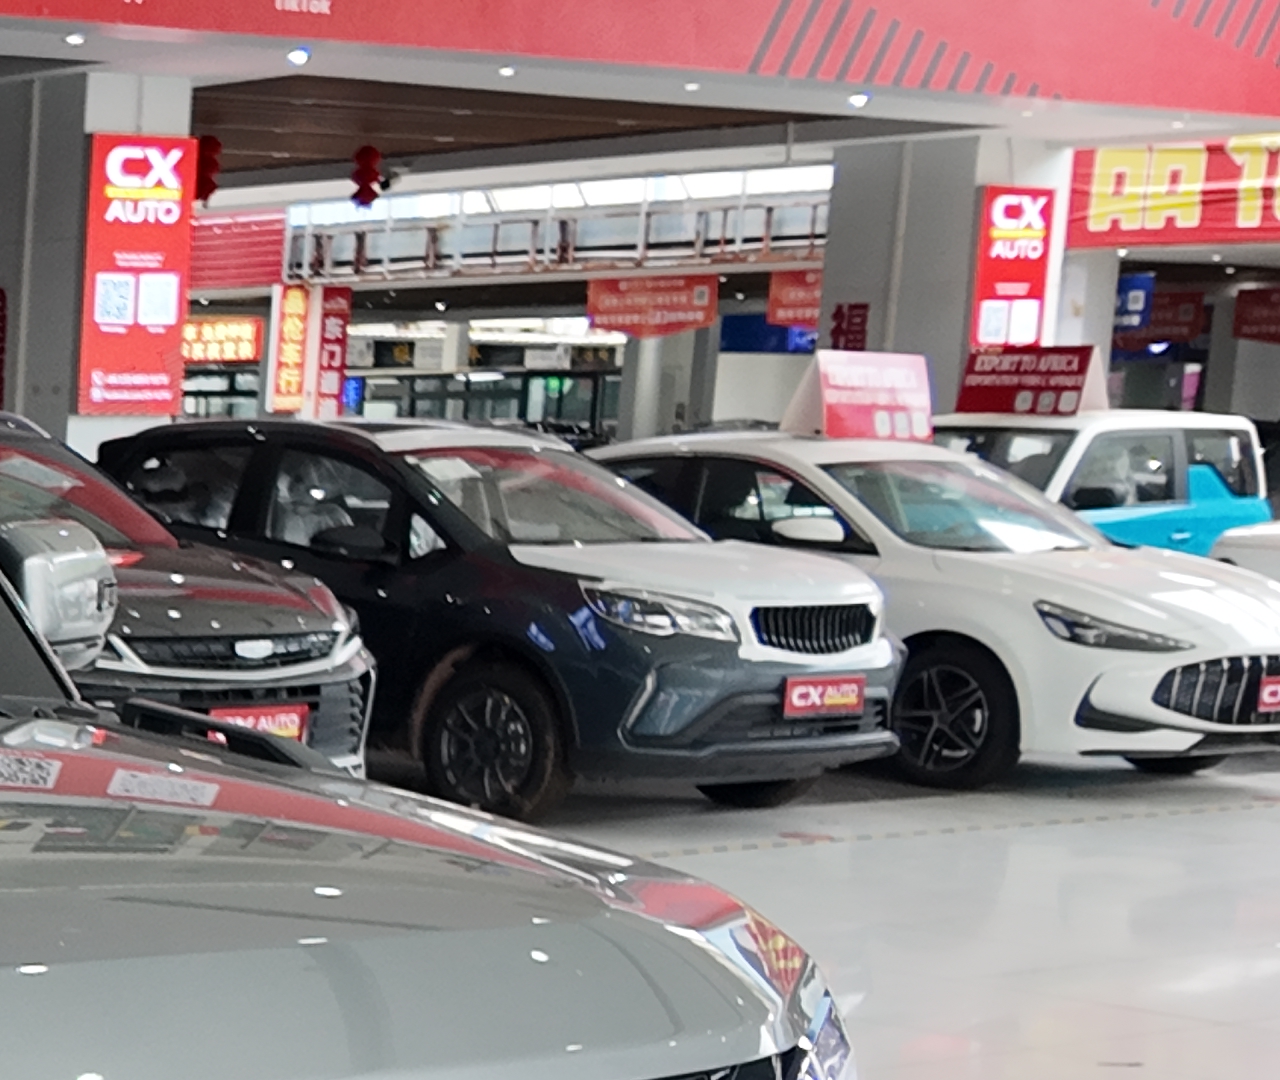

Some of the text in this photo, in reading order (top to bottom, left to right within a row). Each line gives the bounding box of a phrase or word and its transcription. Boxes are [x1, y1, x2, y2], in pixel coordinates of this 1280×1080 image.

[104, 145, 184, 189] CX
[103, 199, 182, 224] AUTO
[991, 194, 1049, 230] CX
[989, 238, 1045, 260] AUTO
[791, 684, 823, 707] CX
